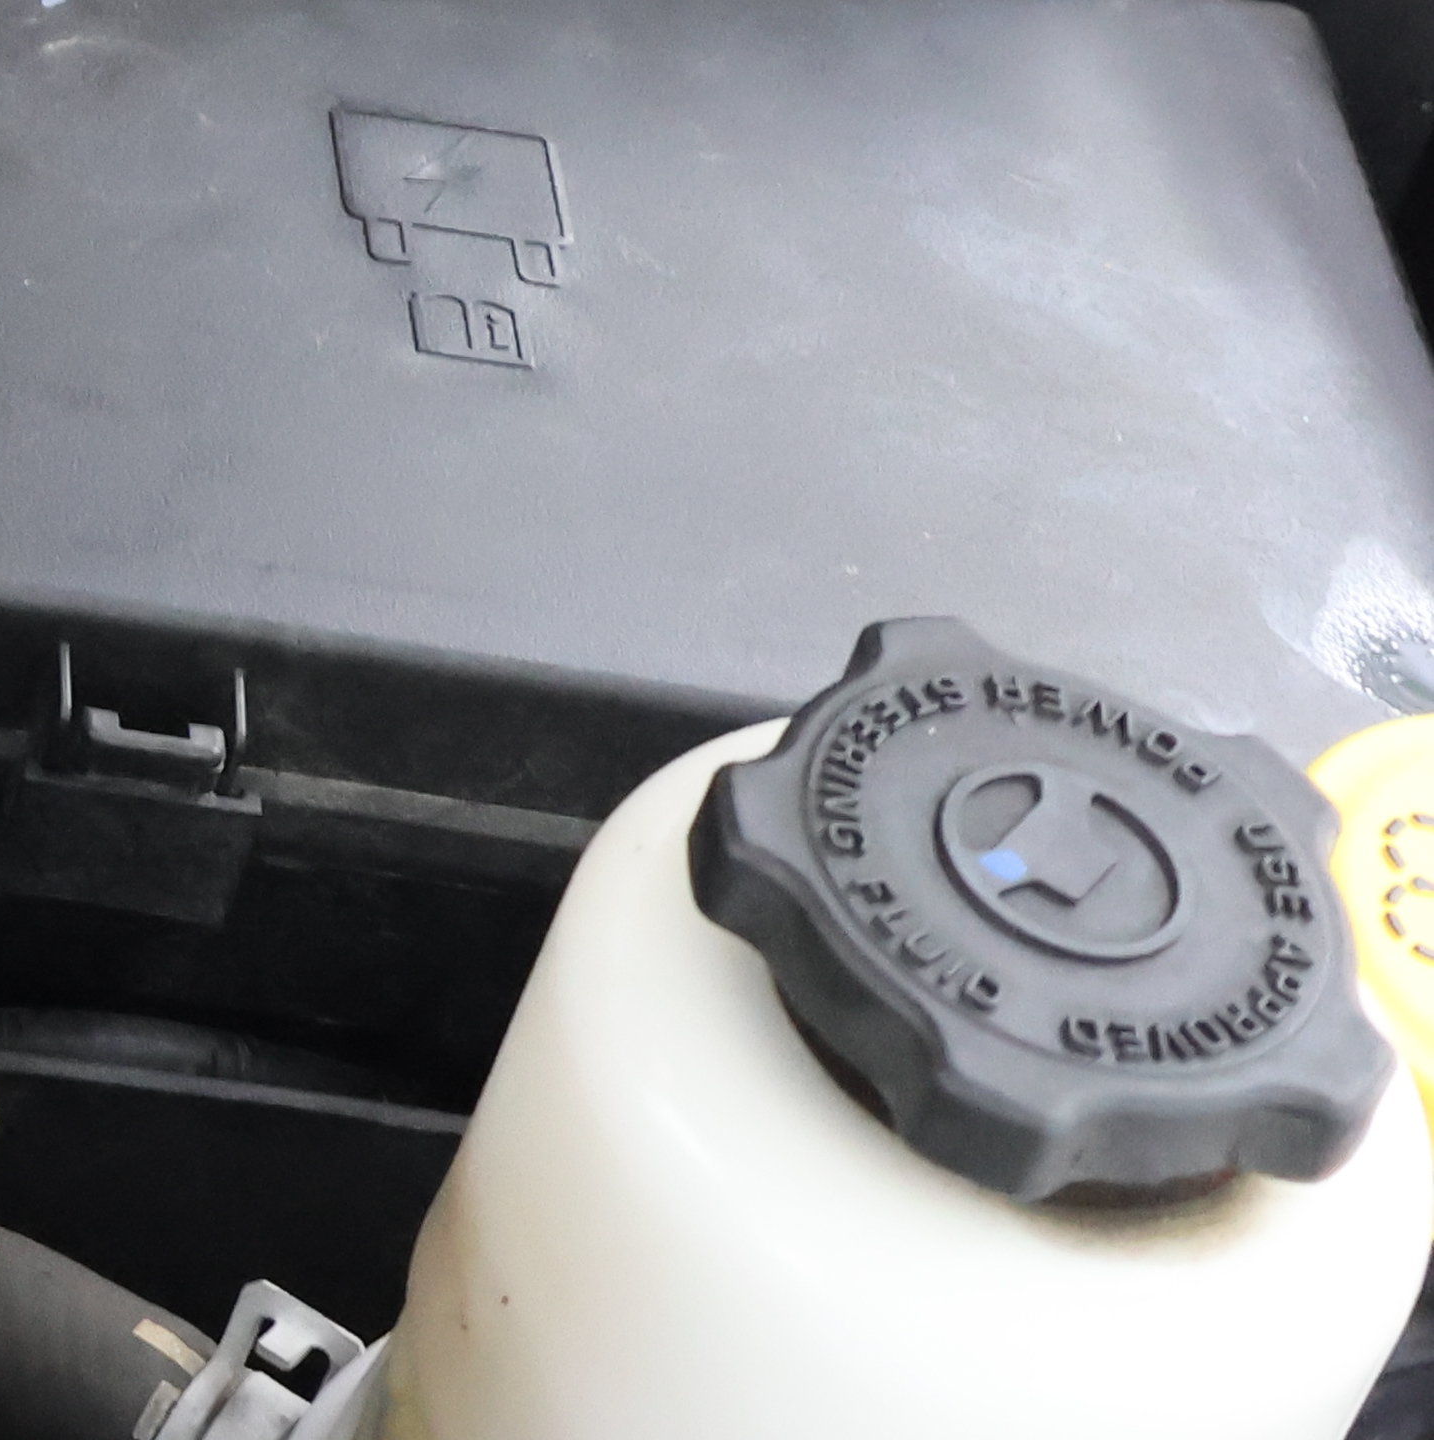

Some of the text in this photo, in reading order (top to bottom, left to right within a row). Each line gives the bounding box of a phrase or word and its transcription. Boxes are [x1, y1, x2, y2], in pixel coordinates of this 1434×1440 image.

[814, 674, 969, 859] STEERING
[982, 674, 1222, 793] POWER
[1058, 817, 1316, 1064] USE APPROVED
